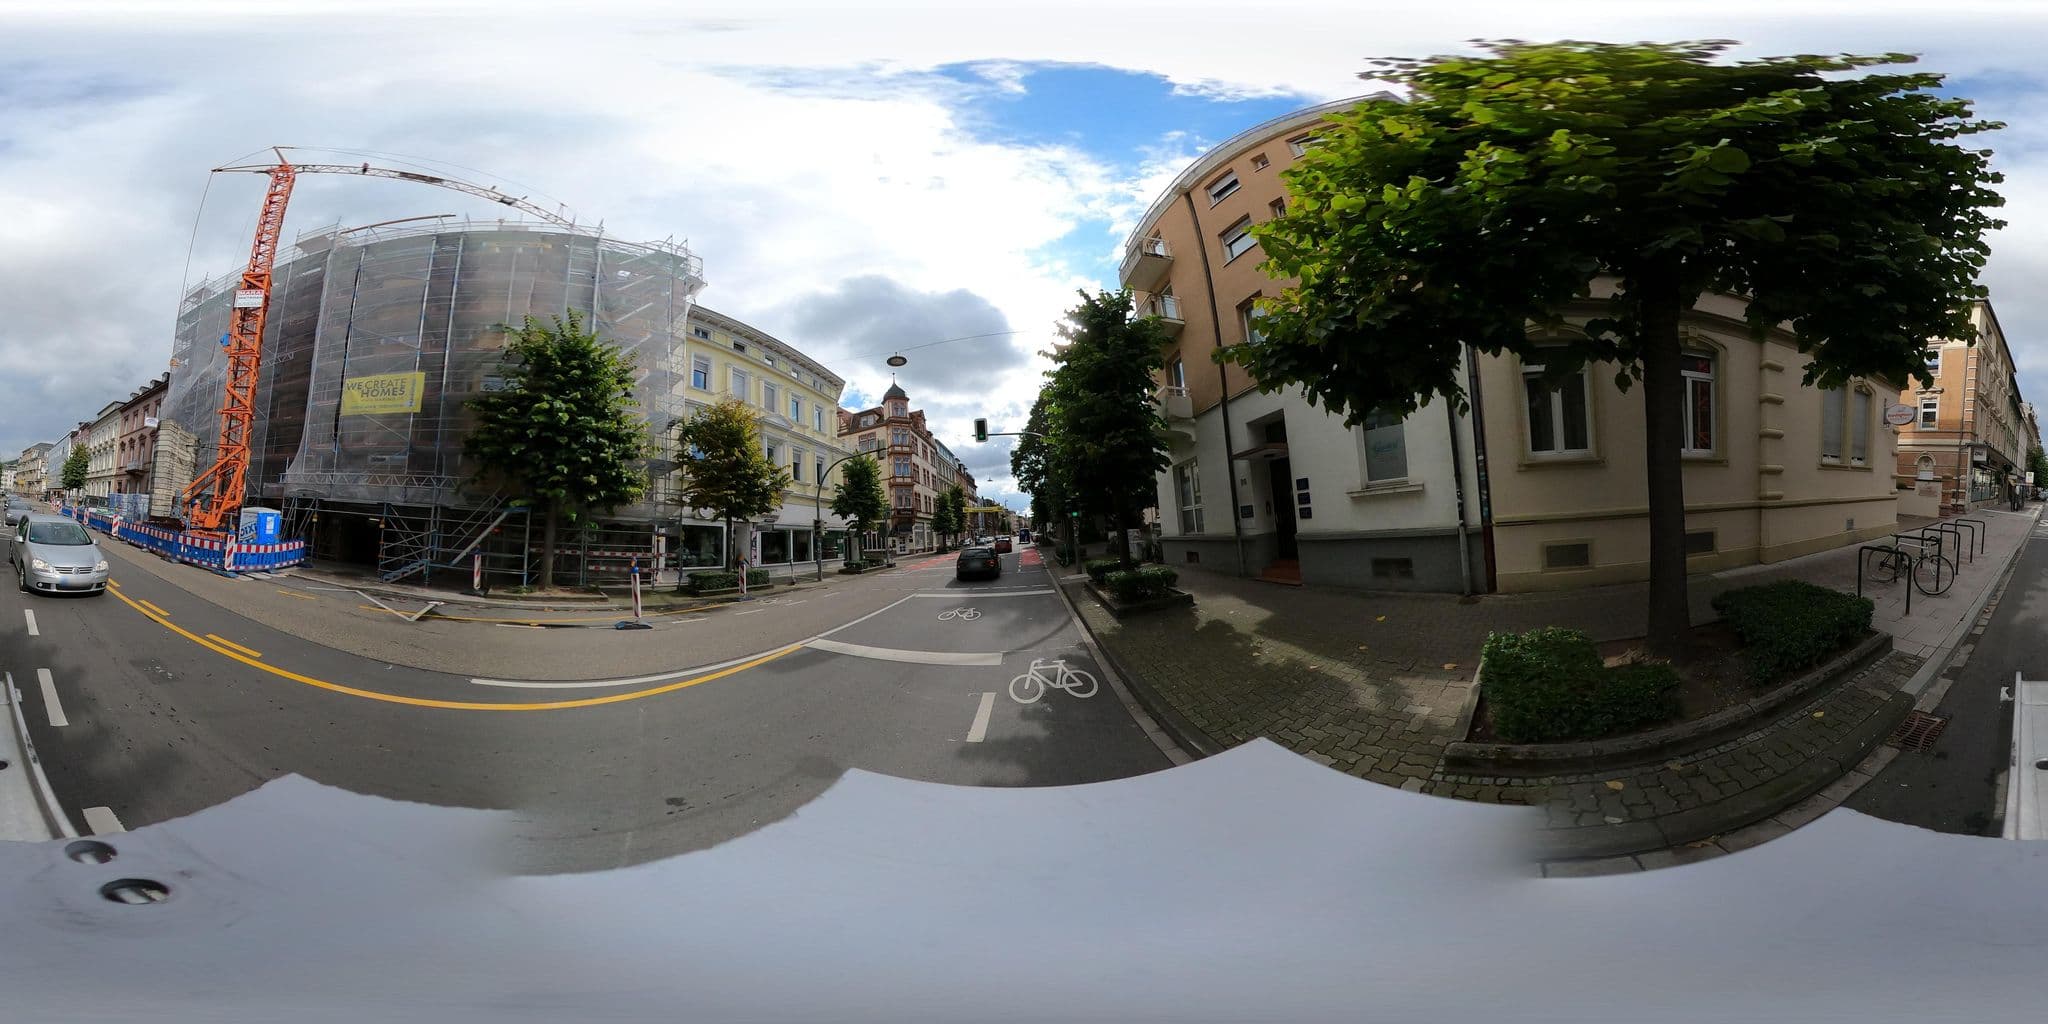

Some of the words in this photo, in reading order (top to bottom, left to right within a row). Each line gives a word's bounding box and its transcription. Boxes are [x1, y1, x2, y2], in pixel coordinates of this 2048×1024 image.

[346, 381, 363, 390] WE
[365, 378, 407, 390] CREATE
[361, 387, 405, 398] HOMES
